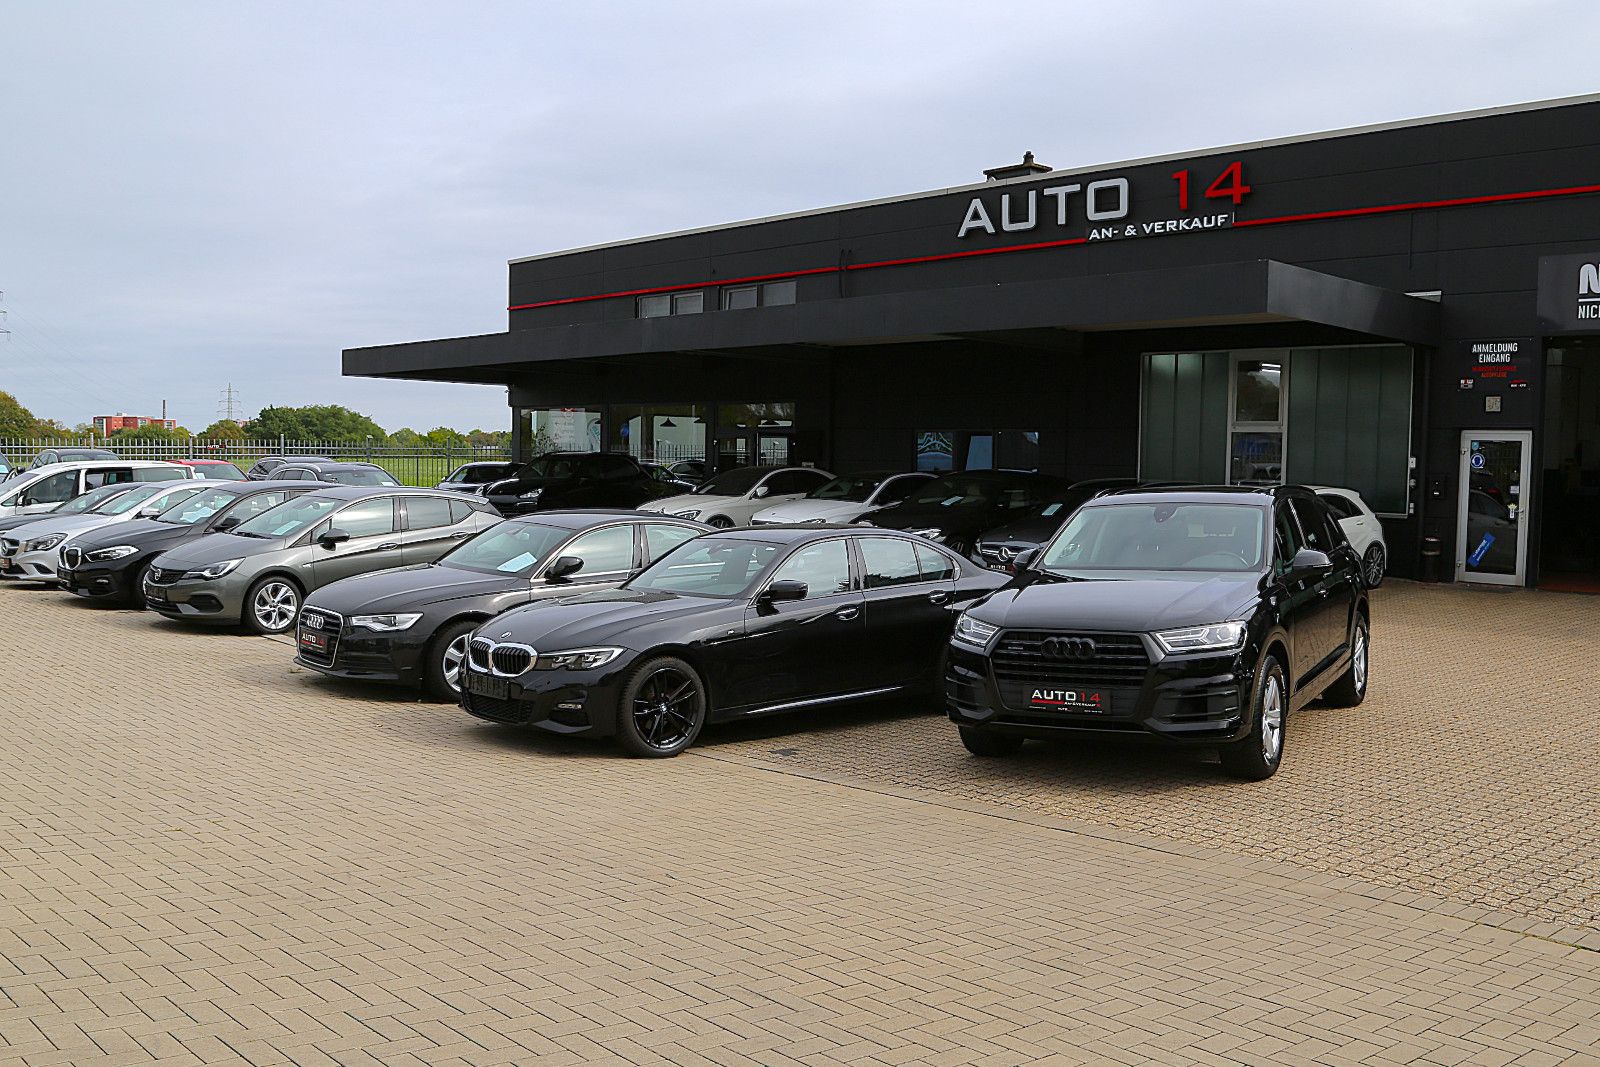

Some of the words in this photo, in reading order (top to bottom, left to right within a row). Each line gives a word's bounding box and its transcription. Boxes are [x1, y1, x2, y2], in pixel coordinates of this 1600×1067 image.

[957, 178, 1129, 237] AUTO
[1171, 161, 1251, 211] 14
[1089, 227, 1119, 240] AN-
[1124, 225, 1137, 236] &
[1142, 214, 1229, 234] VERKAUF
[1578, 304, 1600, 319] NIC
[1472, 342, 1518, 353] ANMELDUNG
[1478, 353, 1511, 363] EINGANG
[302, 633, 316, 643] AUTO
[1032, 690, 1076, 701] AUTO
[1081, 692, 1101, 702] 14
